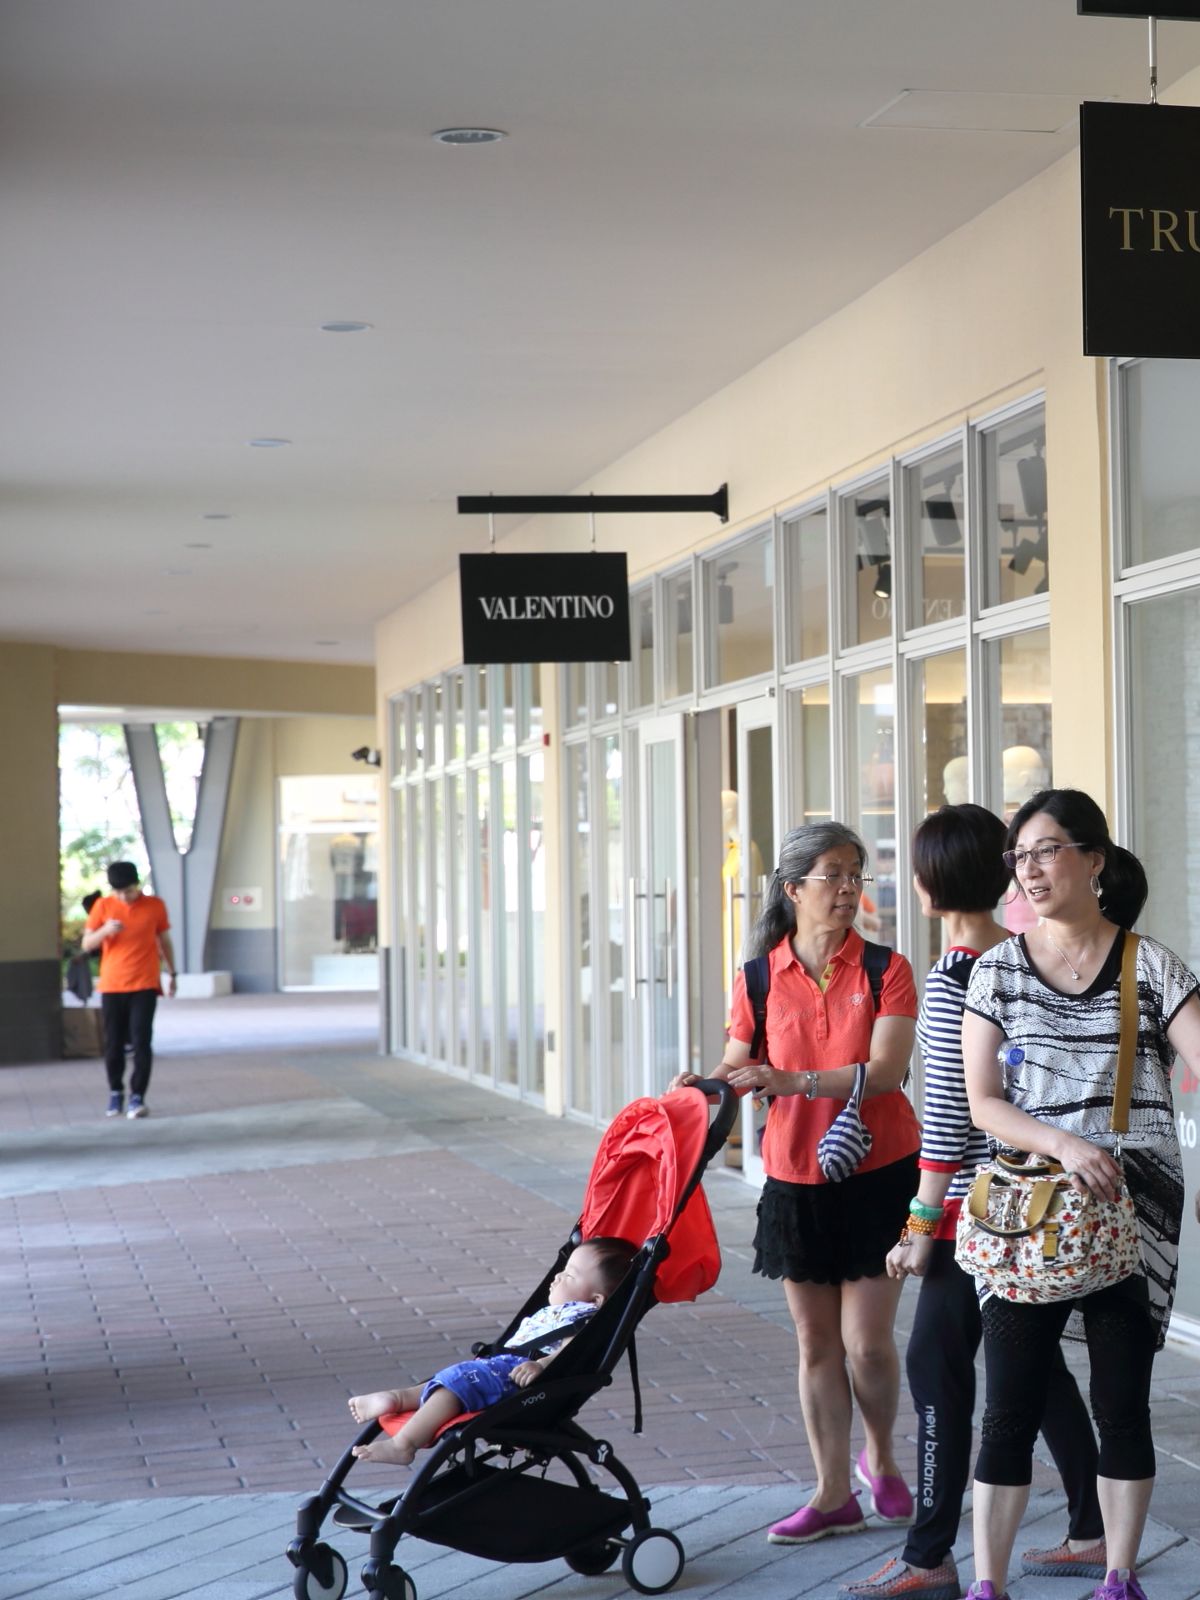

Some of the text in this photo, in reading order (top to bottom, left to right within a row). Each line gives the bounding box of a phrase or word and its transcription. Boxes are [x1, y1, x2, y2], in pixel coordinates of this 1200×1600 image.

[478, 595, 615, 620] VALENTINO
[1178, 1111, 1197, 1149] to
[922, 1405, 939, 1508] new balance
